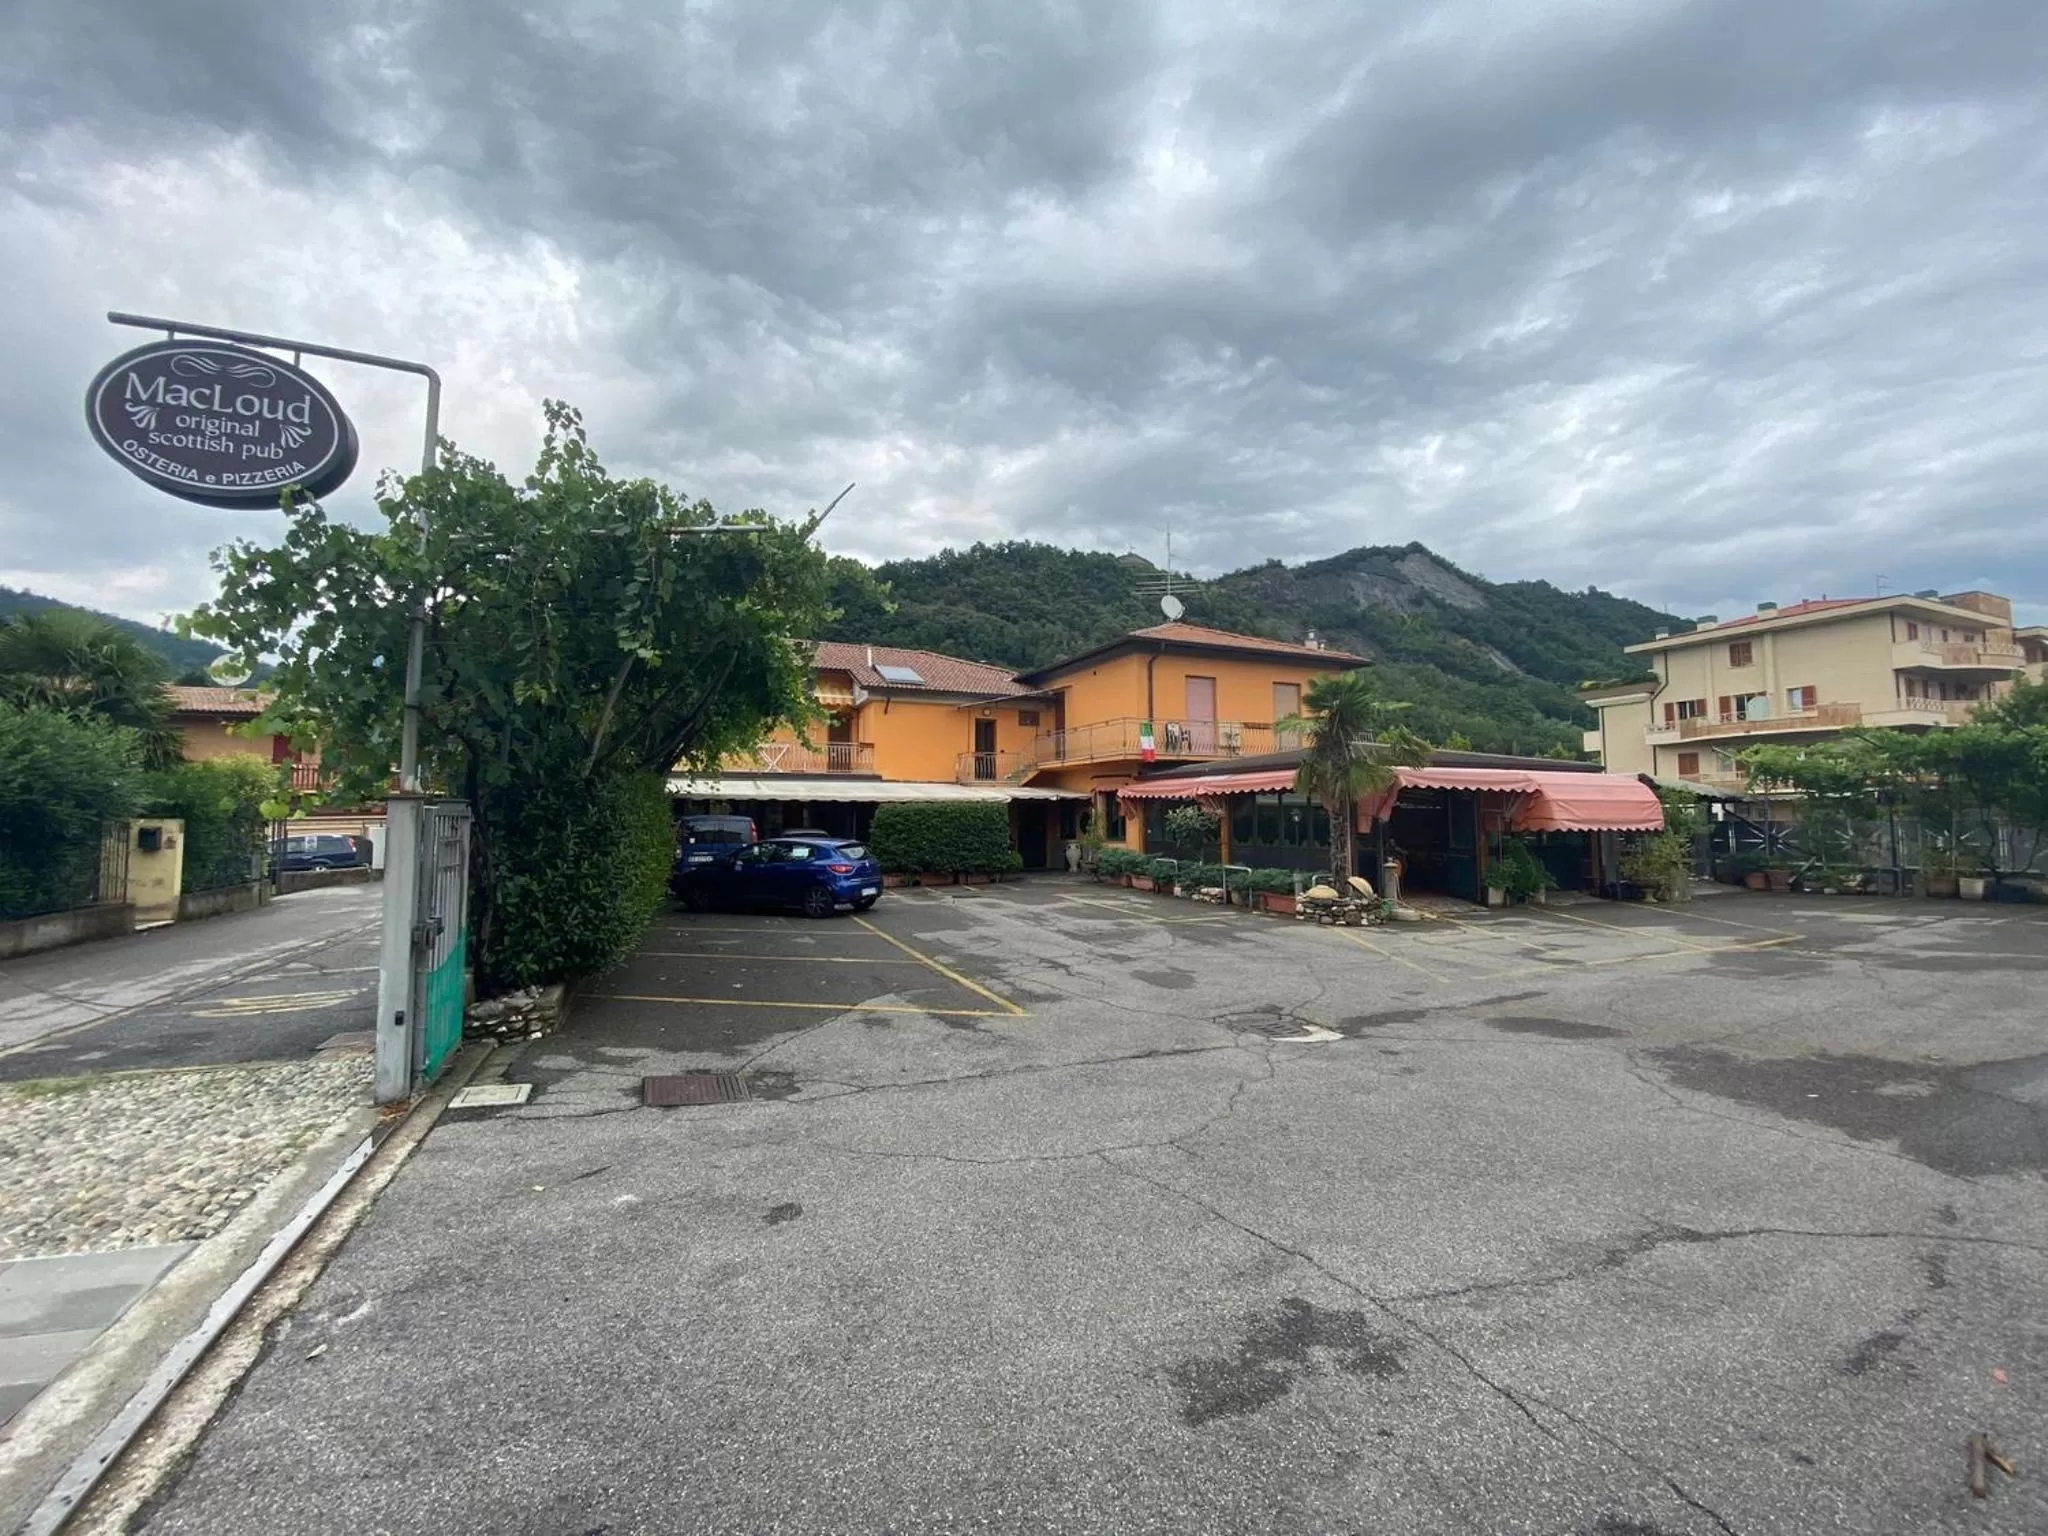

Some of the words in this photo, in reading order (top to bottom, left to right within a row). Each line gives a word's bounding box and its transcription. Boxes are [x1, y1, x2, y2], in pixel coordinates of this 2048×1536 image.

[125, 372, 311, 423] MacLoud
[175, 414, 260, 437] original
[123, 439, 199, 481] OSTERIA
[205, 473, 216, 484] e
[222, 460, 306, 485] PIZZERIA
[148, 430, 234, 453] scottish
[241, 442, 284, 460] pub
